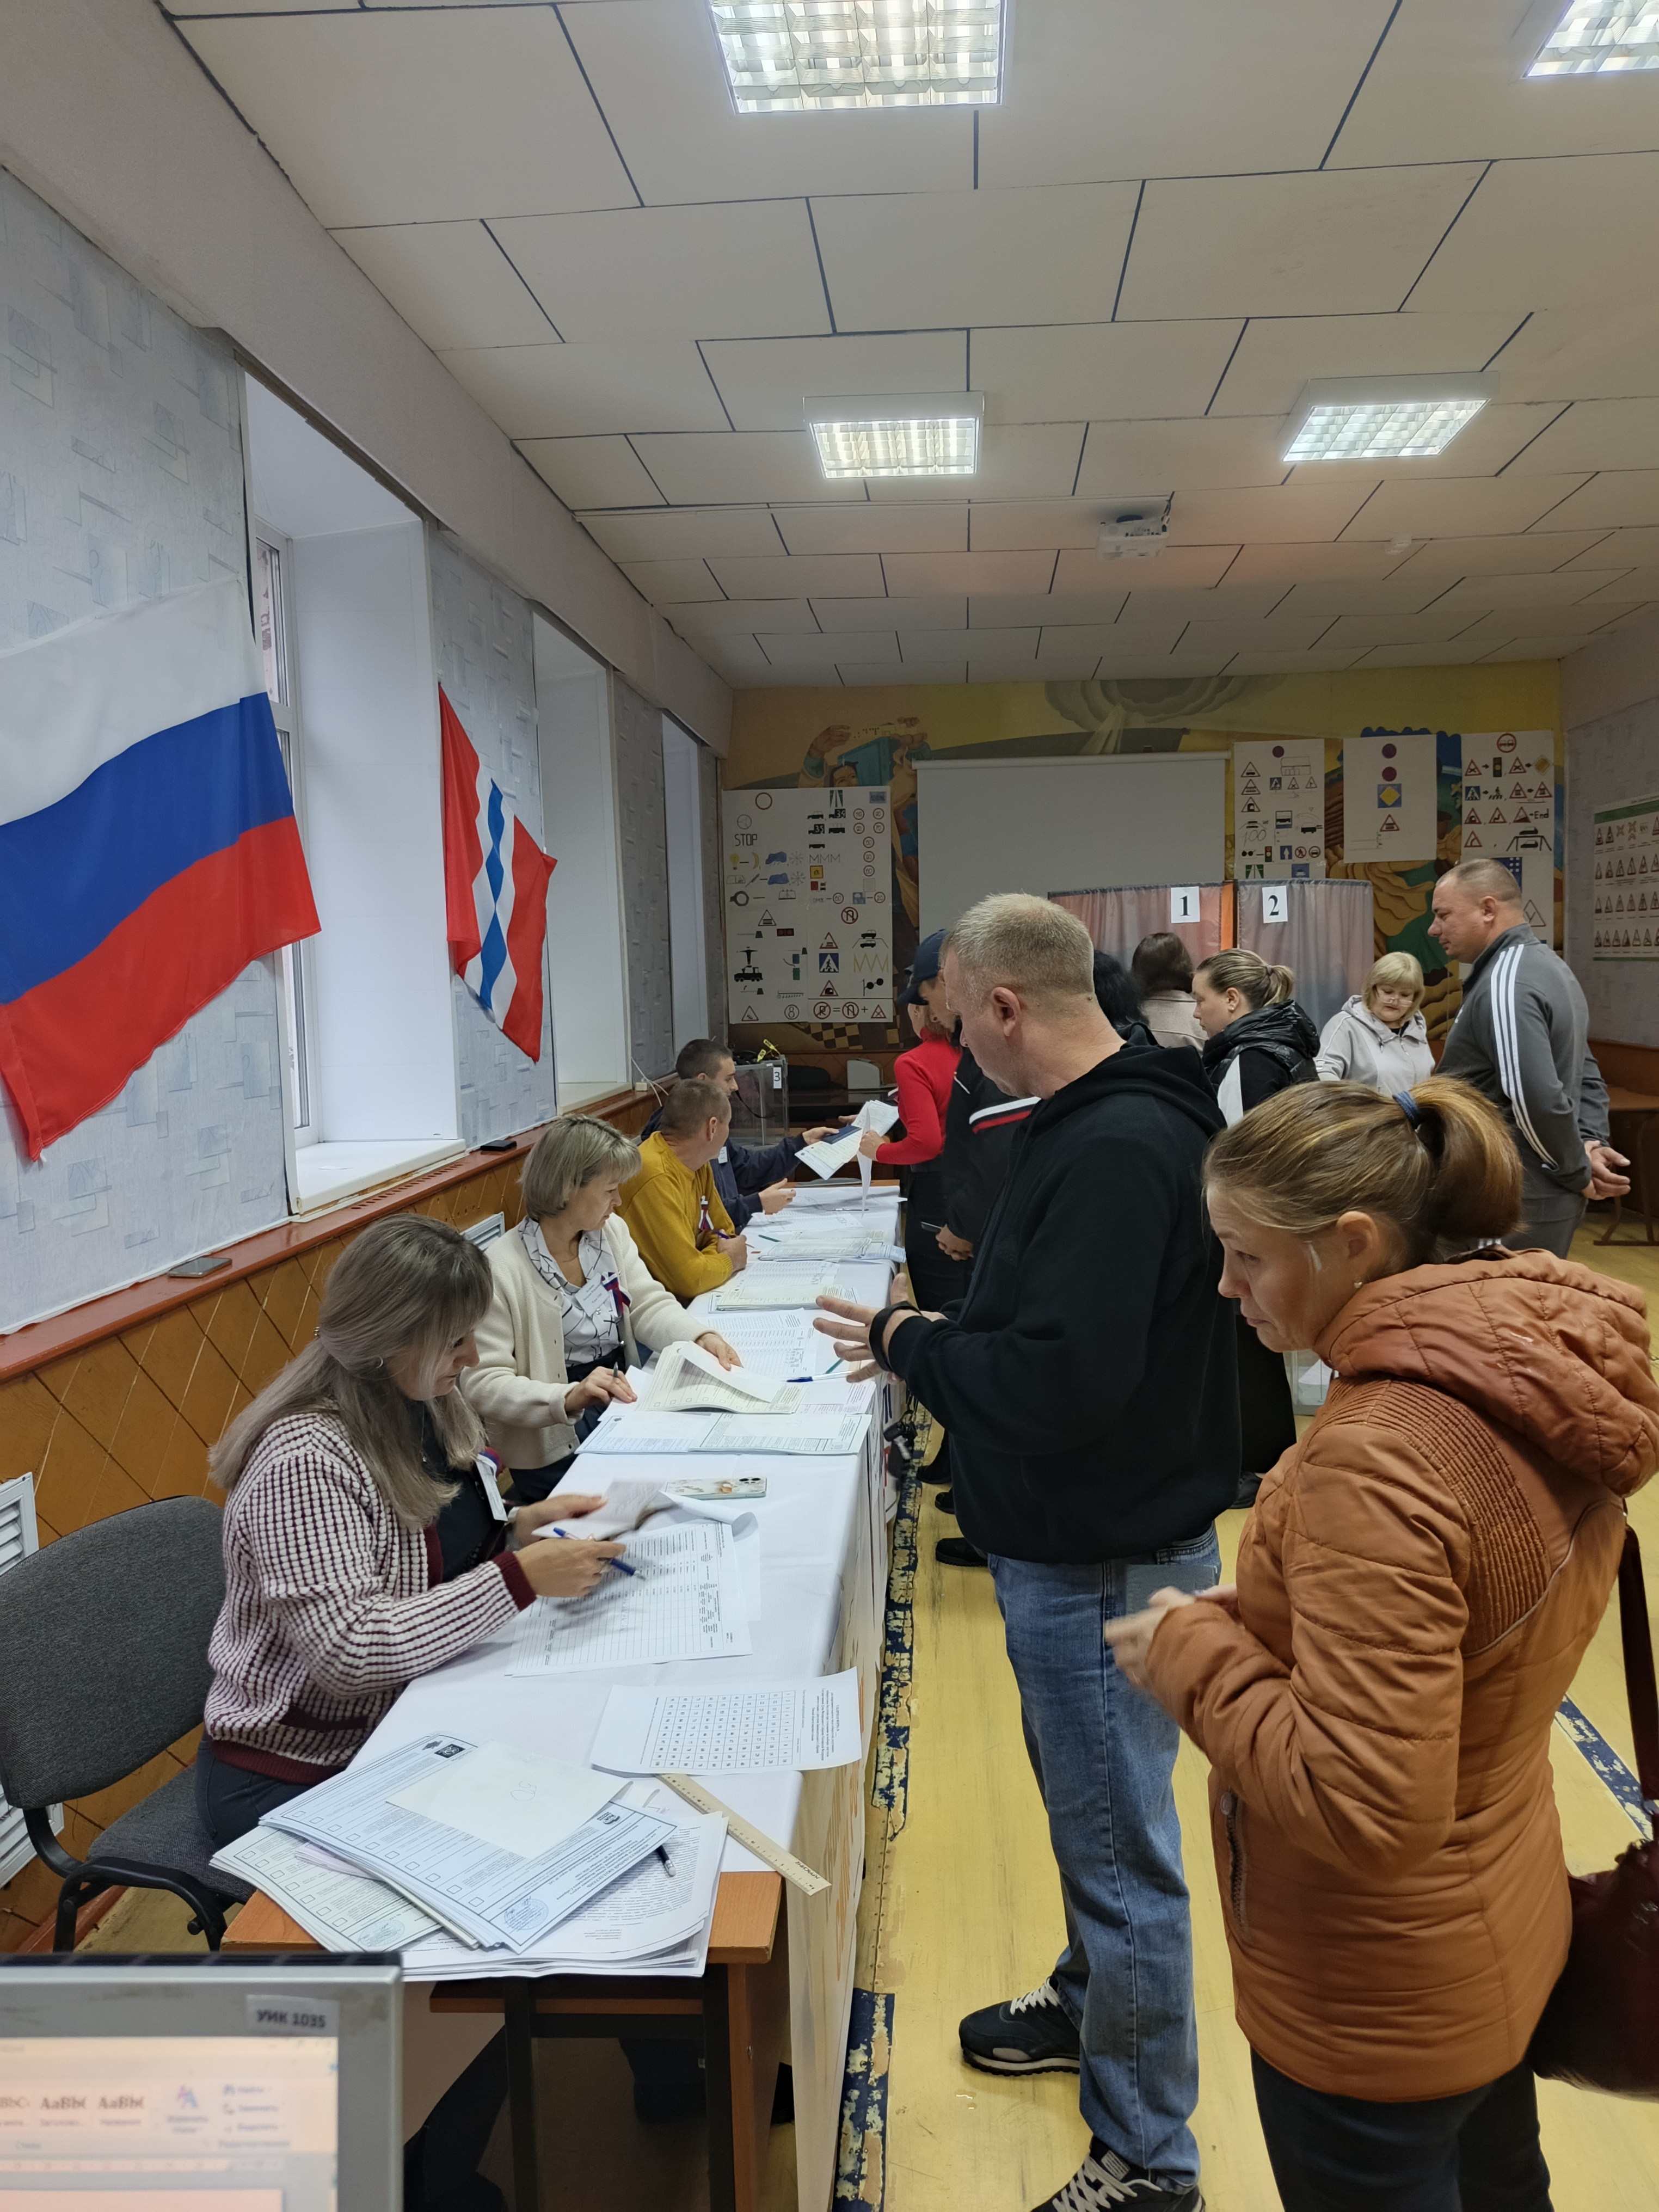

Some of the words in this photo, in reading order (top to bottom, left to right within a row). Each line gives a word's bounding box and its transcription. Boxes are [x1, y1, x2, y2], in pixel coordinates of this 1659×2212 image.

[1534, 808, 1549, 819] End
[734, 833, 758, 846] STOP
[1179, 895, 1191, 917] 1
[1268, 895, 1280, 917] 2
[774, 1071, 781, 1082] 3
[257, 2010, 288, 2023] УИК
[292, 2013, 327, 2028] 1035
